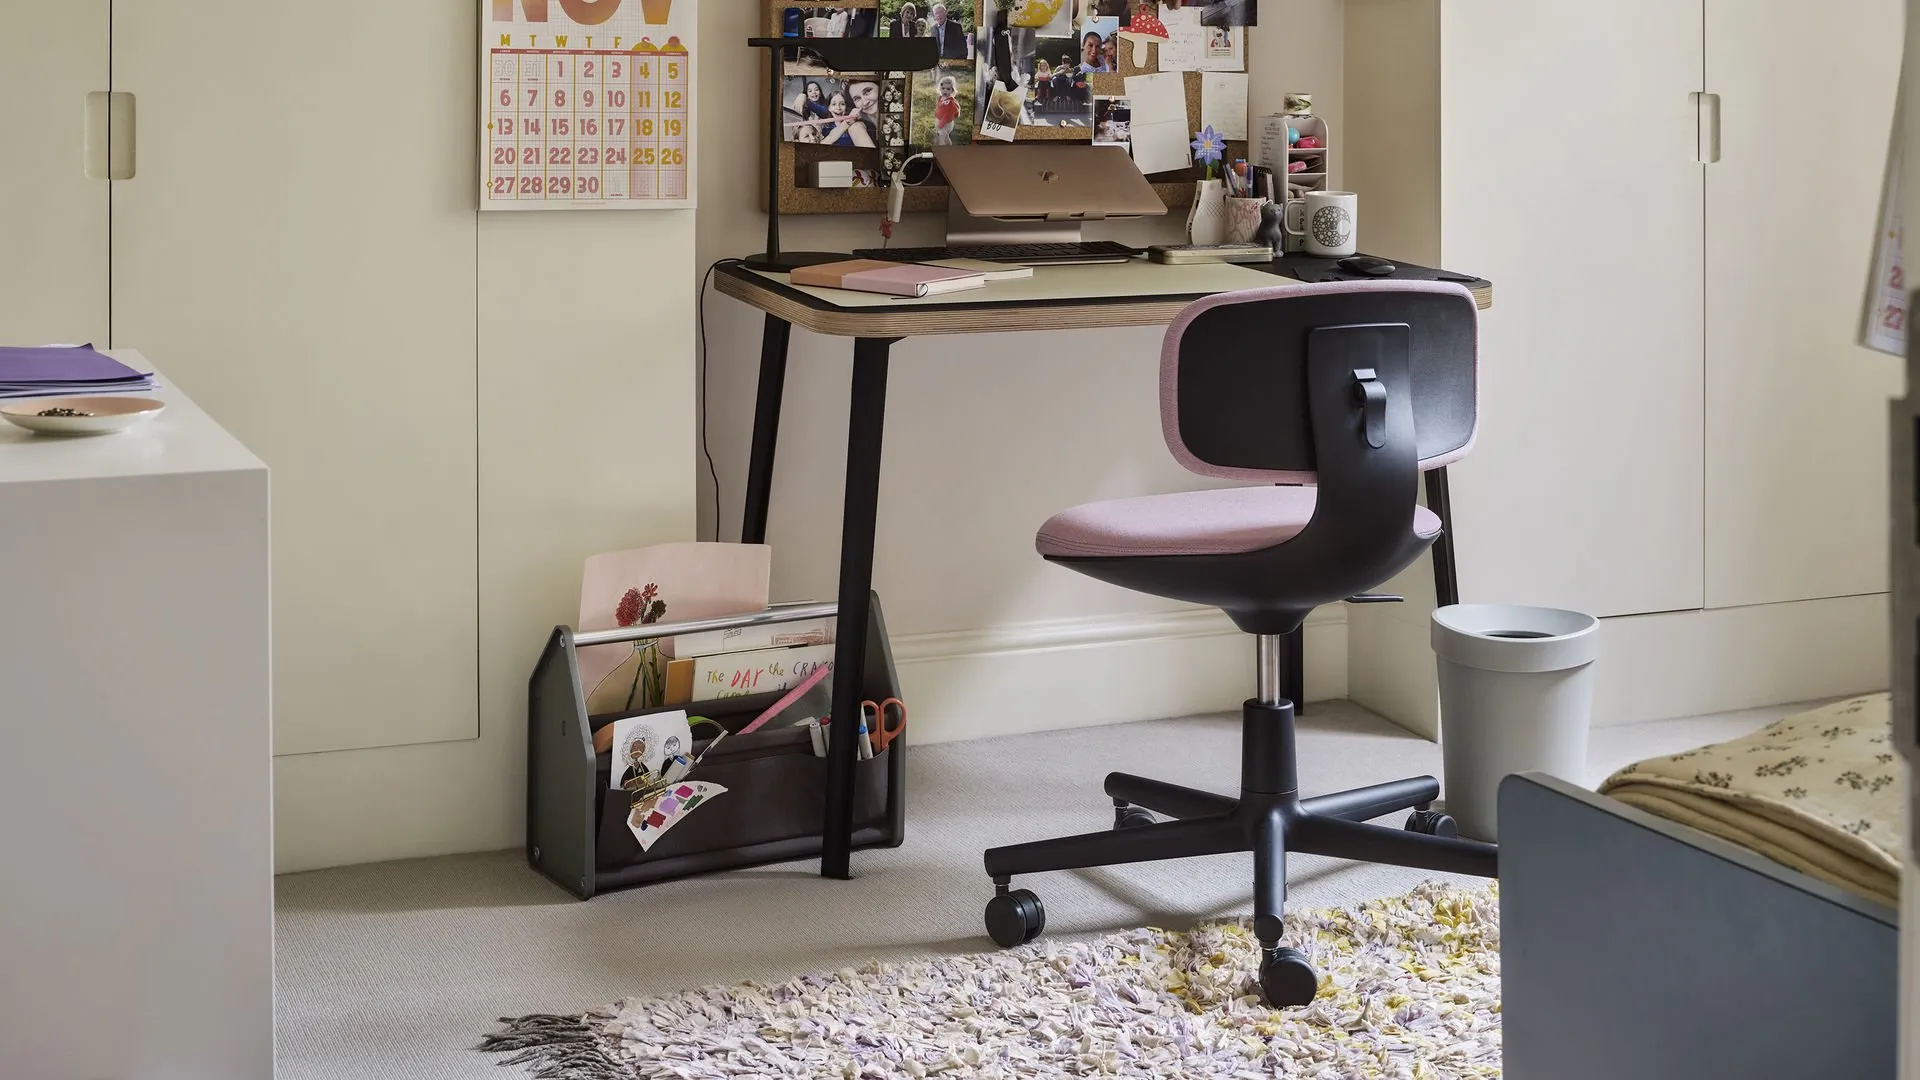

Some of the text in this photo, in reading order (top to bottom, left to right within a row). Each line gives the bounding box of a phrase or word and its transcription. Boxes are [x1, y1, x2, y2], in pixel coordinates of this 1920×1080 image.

[500, 34, 511, 47] M
[529, 34, 537, 47] T
[555, 35, 568, 48] W
[585, 36, 593, 48] T
[614, 36, 622, 48] F
[557, 61, 563, 77] 1
[583, 61, 594, 78] 2
[612, 61, 621, 78] 3
[639, 62, 650, 78] 4
[668, 63, 679, 79] 5
[500, 90, 681, 108] 6 7 8 9 10 11 12
[497, 118, 681, 136] 13 14 15 16 17 18 19
[494, 148, 683, 165] 20 21 22 23 24 25 26
[494, 177, 515, 193] 27
[520, 177, 542, 193] 28
[548, 177, 571, 193] 29
[577, 177, 599, 193] 30
[707, 670, 725, 684] The
[730, 668, 764, 689] DAY
[768, 662, 784, 676] the
[793, 660, 834, 677] CRAO
